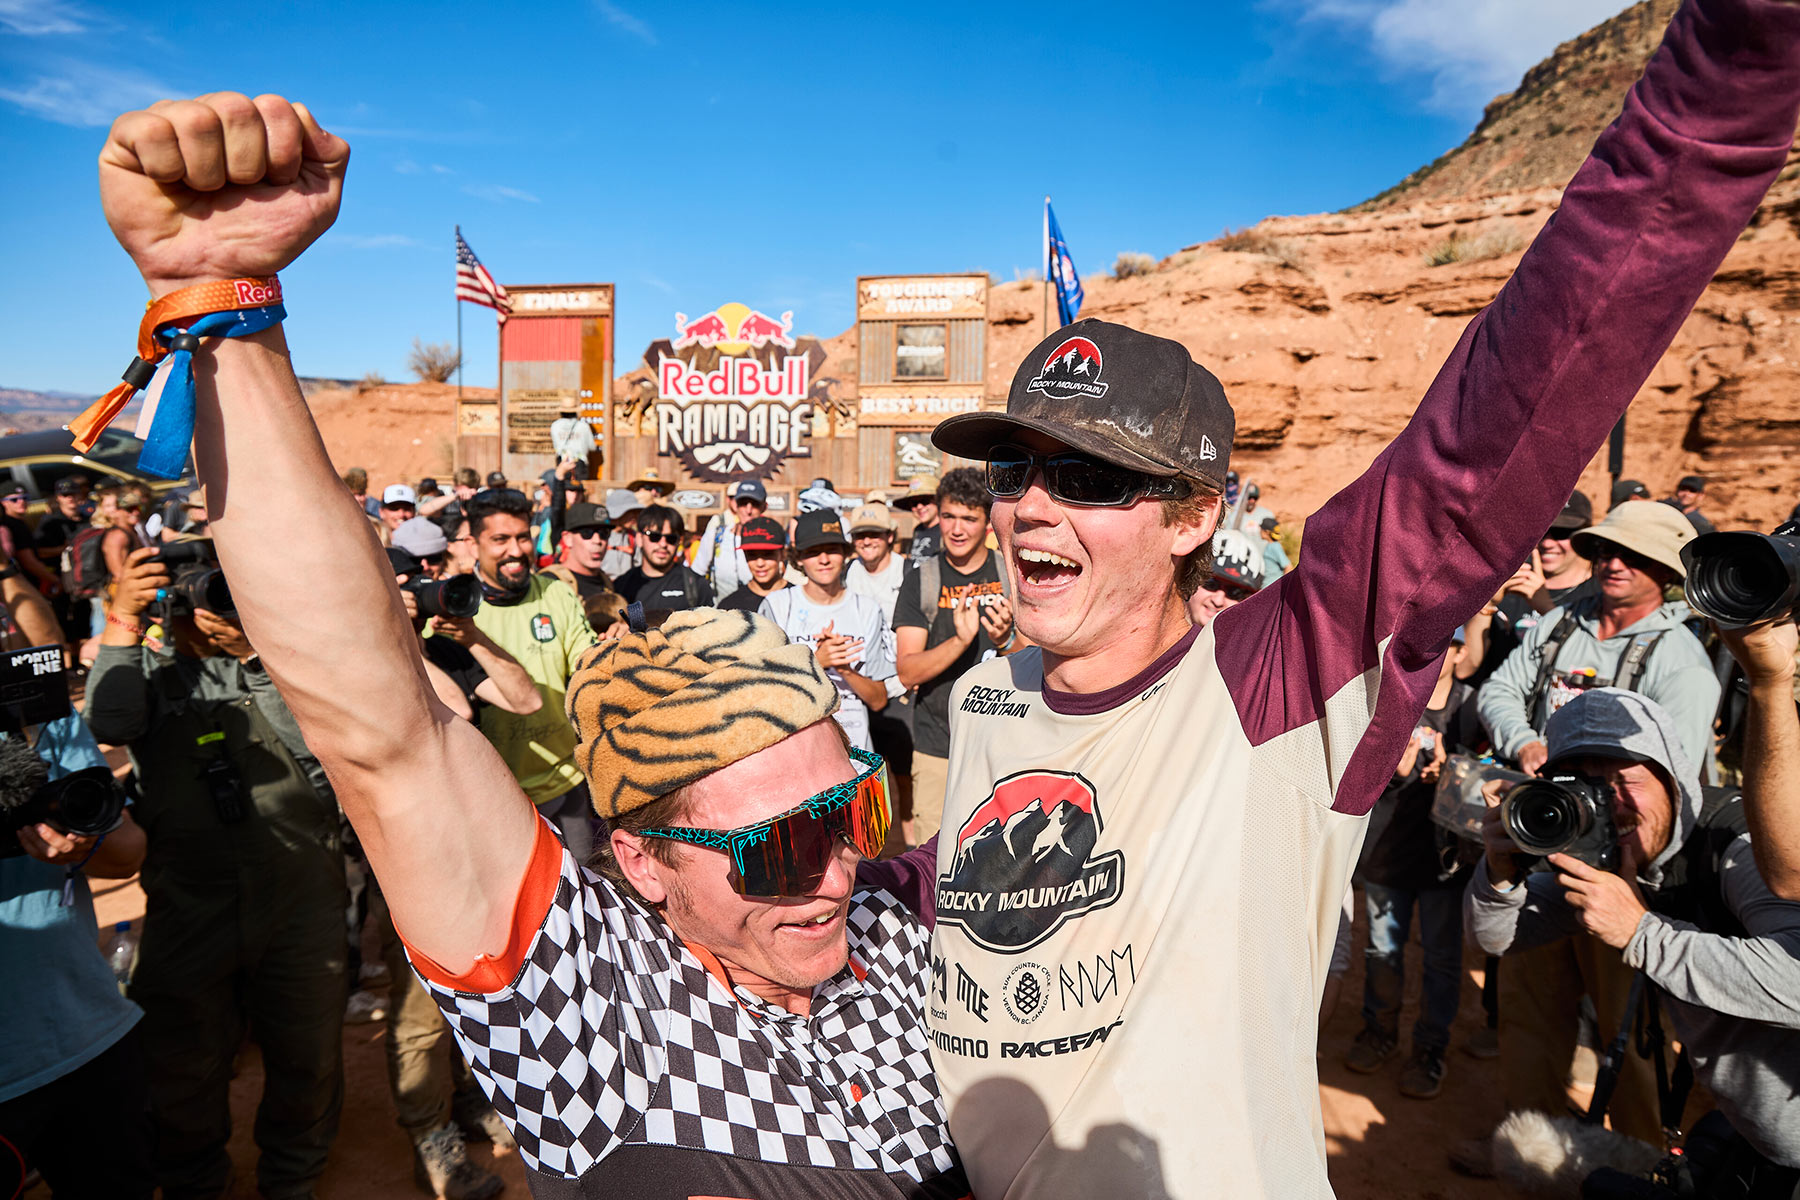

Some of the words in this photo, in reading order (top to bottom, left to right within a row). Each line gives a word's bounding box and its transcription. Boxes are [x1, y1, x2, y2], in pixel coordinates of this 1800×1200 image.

[868, 282, 976, 298] TOUGHNESS
[524, 293, 590, 310] FINALS
[885, 298, 953, 313] AWARD
[663, 360, 729, 396] Red
[738, 360, 805, 396] Bull
[1031, 380, 1057, 388] ROCKY
[1056, 380, 1103, 394] MOUNTAIN
[861, 398, 911, 414] BEST
[915, 397, 981, 413] TRICK
[656, 403, 812, 454] RAMPAGE
[966, 685, 1016, 703] ROCKY
[959, 697, 1031, 719] MOUNTAIN
[938, 889, 992, 912] ROCKY
[998, 871, 1110, 912] MOUNTAIN
[1002, 975, 1012, 991] SUN
[1010, 961, 1041, 975] COUNTRY
[1002, 997, 1021, 1023] VERNON
[1031, 994, 1050, 1022] CANADA
